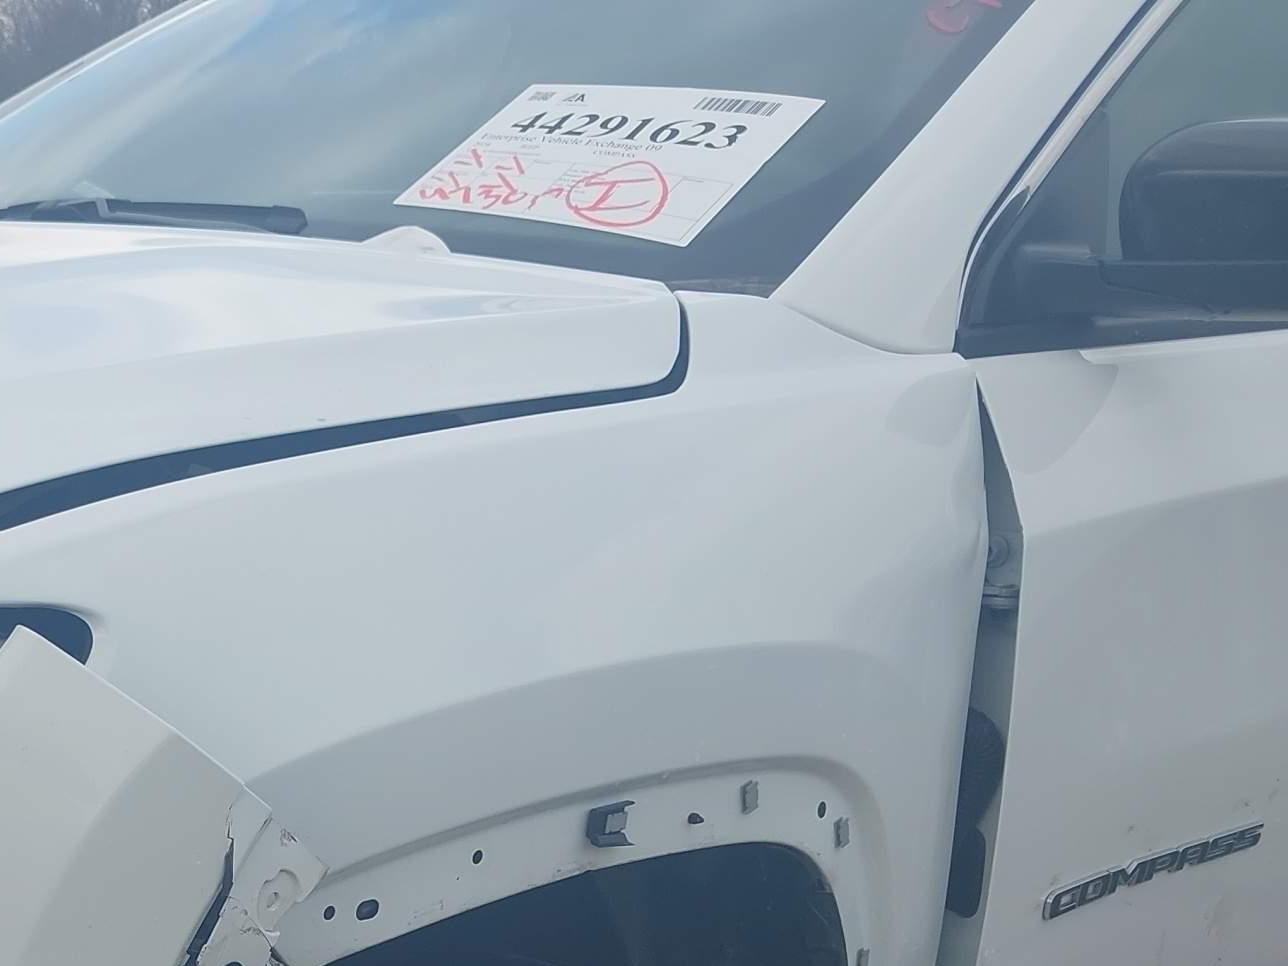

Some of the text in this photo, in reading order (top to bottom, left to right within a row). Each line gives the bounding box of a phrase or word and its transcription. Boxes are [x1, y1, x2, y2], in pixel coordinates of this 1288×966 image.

[511, 111, 748, 150] 44291623
[540, 136, 583, 146] Vehicle
[584, 138, 643, 152] Exchange
[1042, 820, 1264, 921] COMPASS
